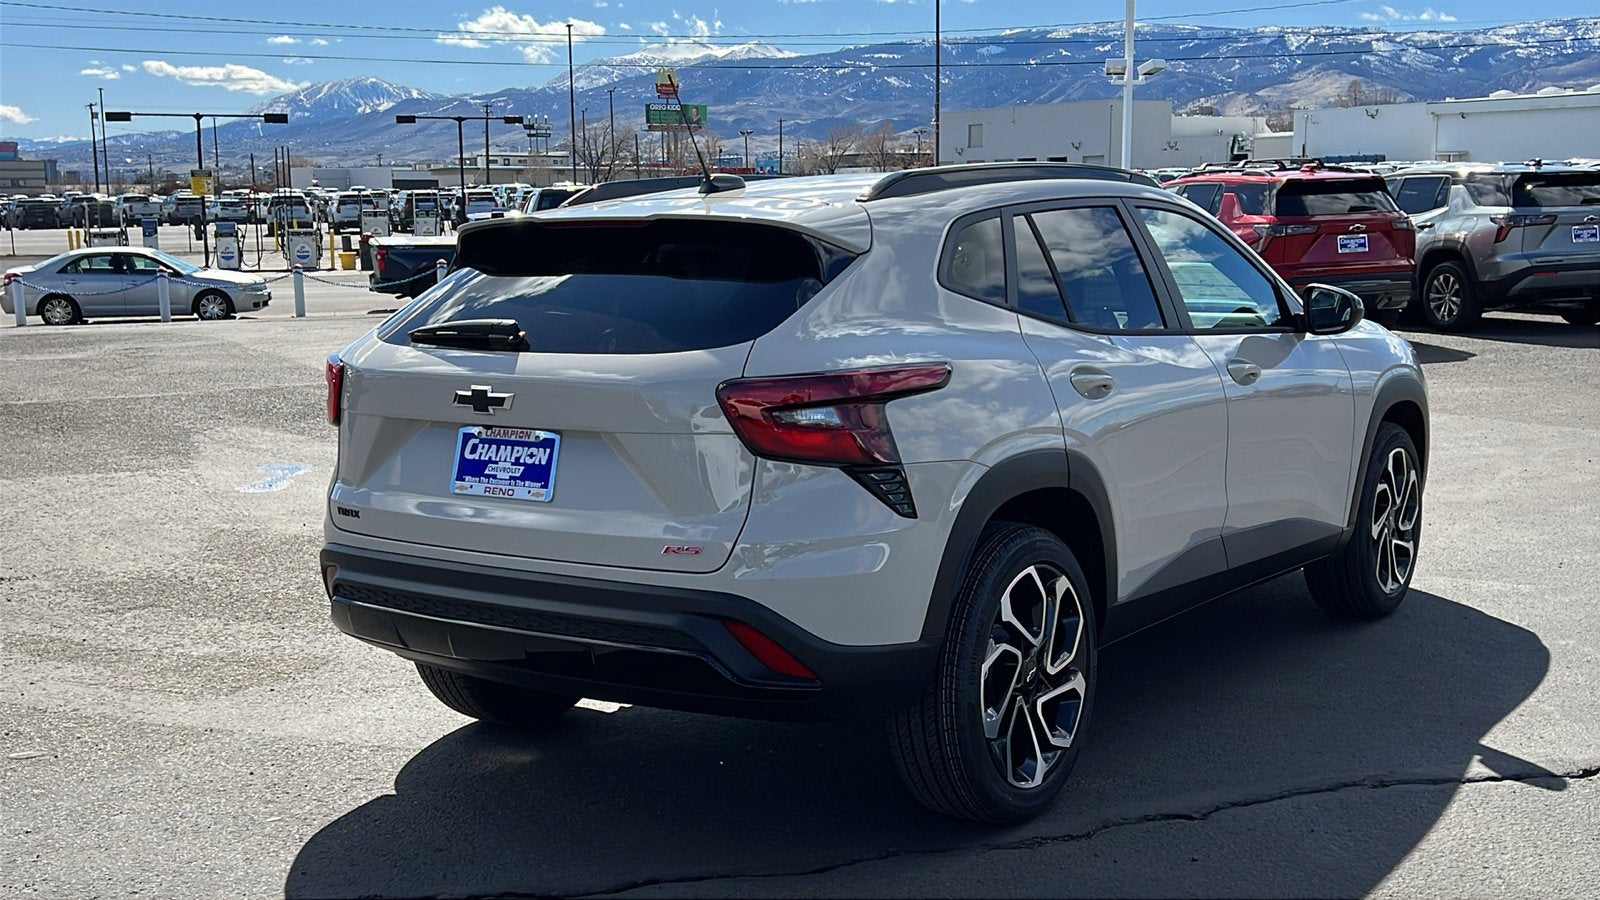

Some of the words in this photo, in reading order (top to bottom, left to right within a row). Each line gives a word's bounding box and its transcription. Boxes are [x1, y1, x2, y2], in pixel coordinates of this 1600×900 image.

[485, 427, 532, 440] CHAMPION
[464, 438, 551, 465] CHAMPION
[488, 465, 521, 475] CHEVROLET
[484, 487, 515, 496] RENO
[337, 506, 361, 519] TRAX
[661, 545, 702, 555] RS
